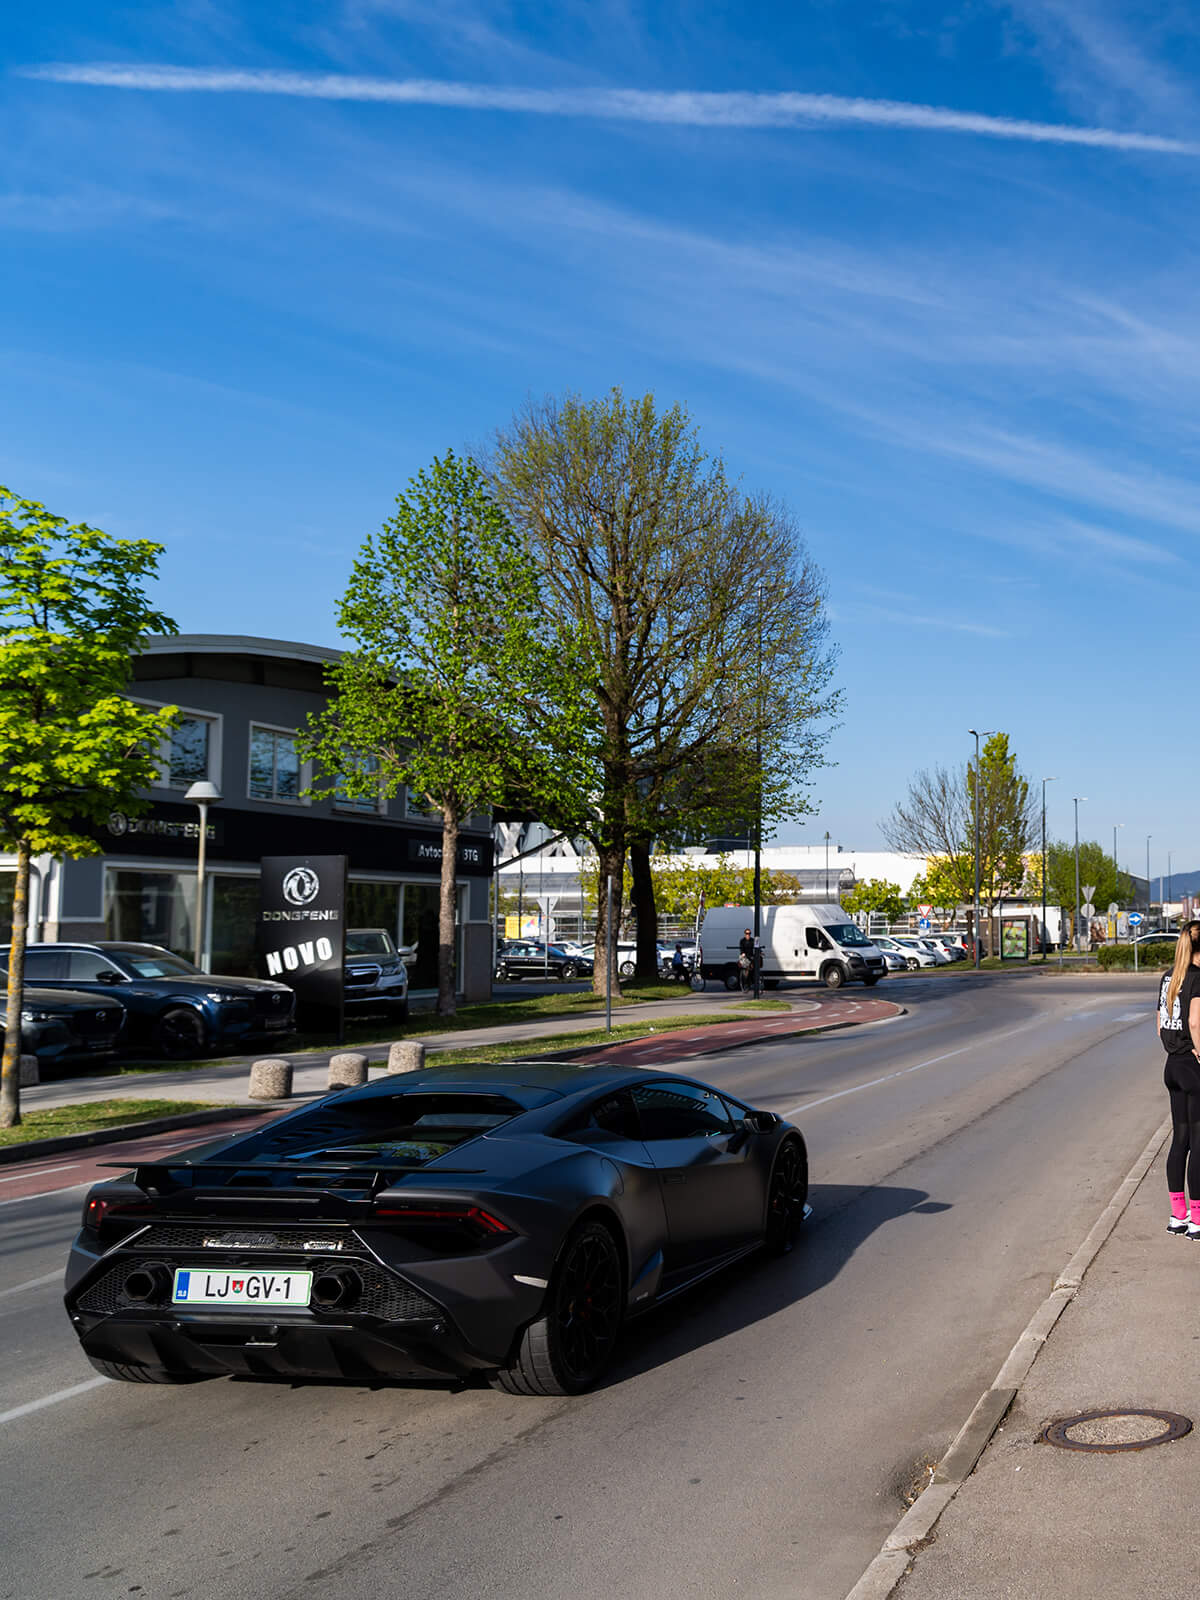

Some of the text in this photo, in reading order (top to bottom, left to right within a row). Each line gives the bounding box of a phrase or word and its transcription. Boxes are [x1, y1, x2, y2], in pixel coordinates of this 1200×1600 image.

[263, 910, 339, 921] DONGFENG
[266, 937, 333, 976] NOVO
[205, 1275, 292, 1300] LJ GV-1
